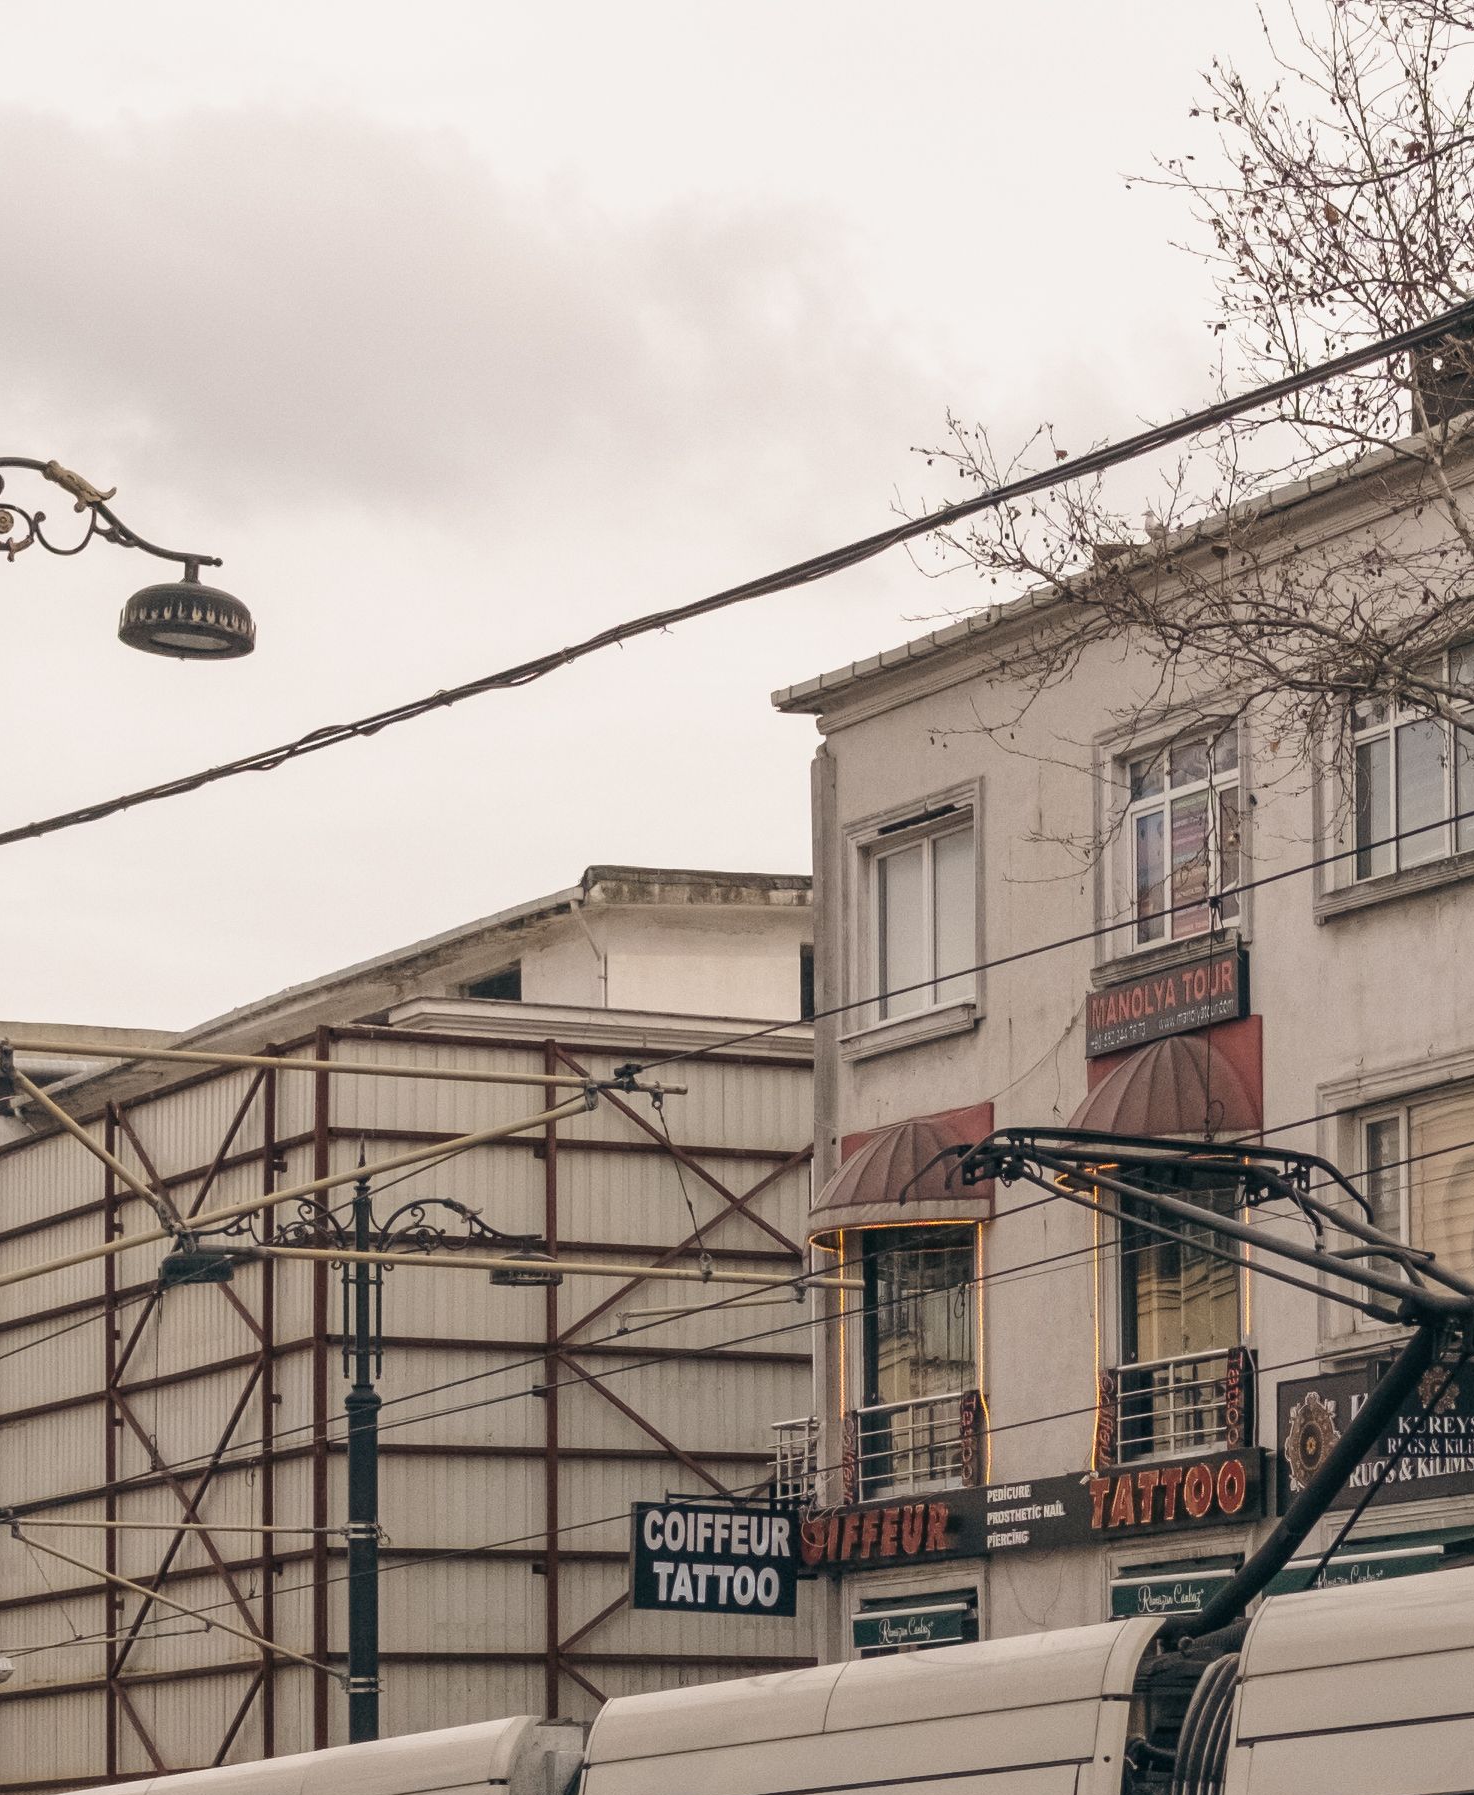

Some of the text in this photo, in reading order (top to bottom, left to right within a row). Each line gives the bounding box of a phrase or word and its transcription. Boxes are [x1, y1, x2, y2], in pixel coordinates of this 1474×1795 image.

[1092, 961, 1233, 1029] MANOLYA TOUR
[1388, 1438, 1426, 1454] RGS
[1090, 1459, 1245, 1529] TATTOO
[643, 1510, 791, 1558] COIFFEUR
[801, 1500, 949, 1565] OIFFEUR
[653, 1561, 780, 1608] TATTOO
